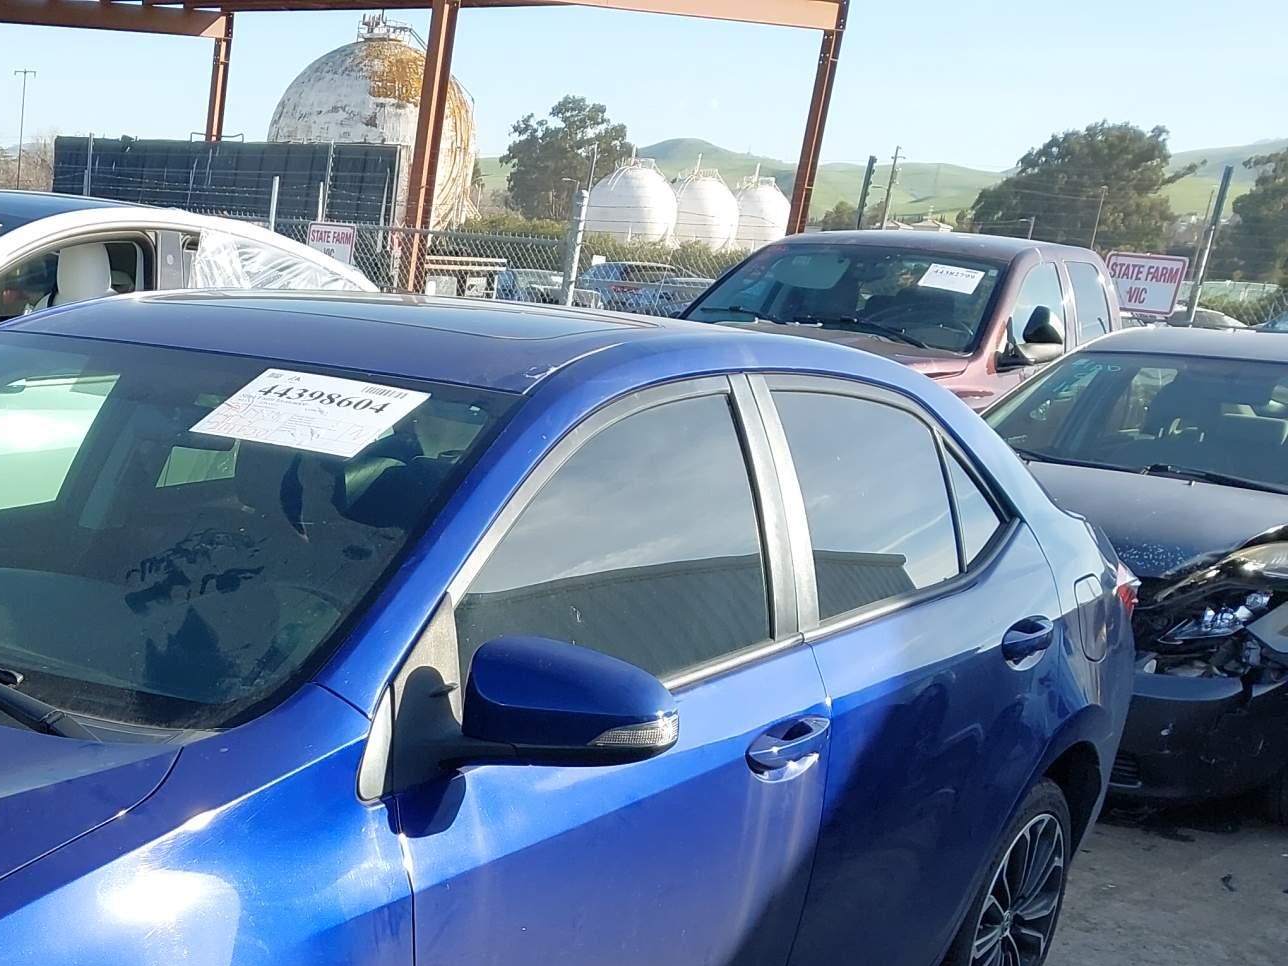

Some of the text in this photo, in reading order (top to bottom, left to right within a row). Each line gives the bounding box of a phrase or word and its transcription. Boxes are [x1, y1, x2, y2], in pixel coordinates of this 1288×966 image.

[311, 229, 352, 246] STATE FARM
[1109, 261, 1180, 284] STATE FARM
[1127, 286, 1148, 305] VIC
[258, 383, 392, 415] 44398604
